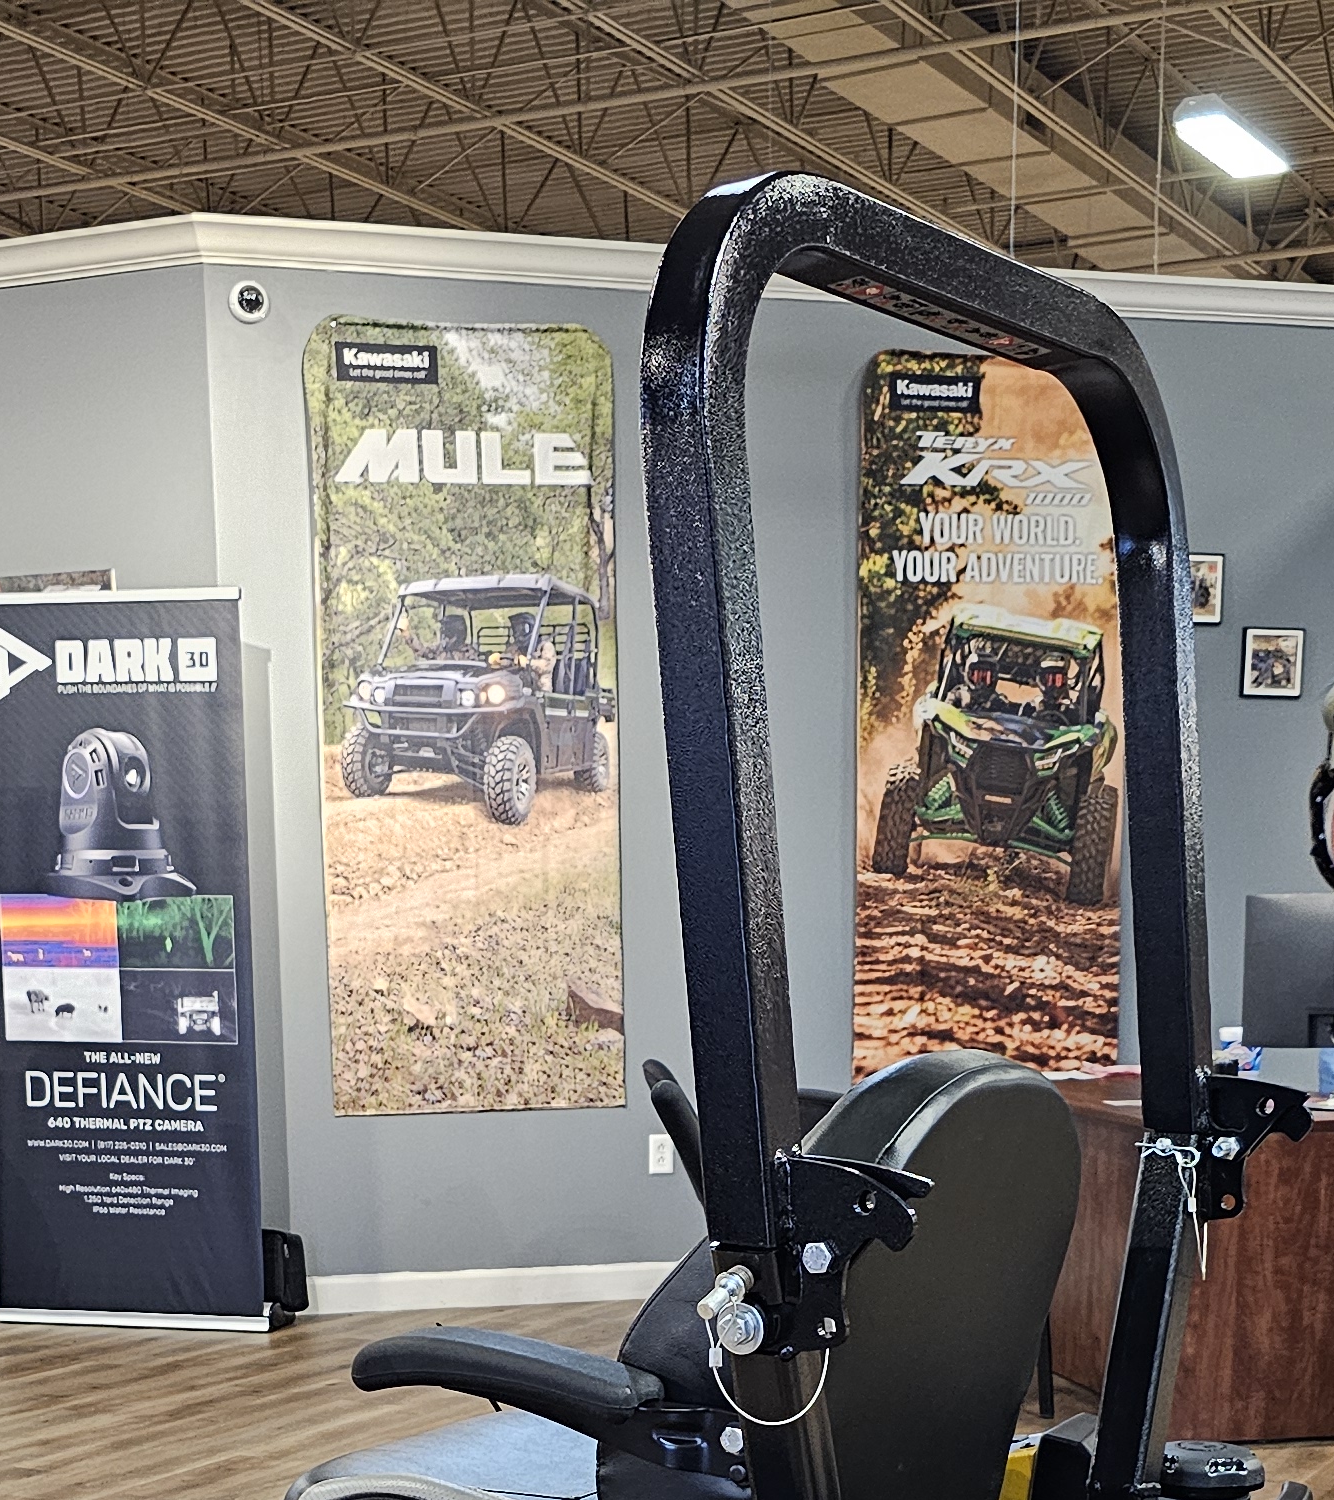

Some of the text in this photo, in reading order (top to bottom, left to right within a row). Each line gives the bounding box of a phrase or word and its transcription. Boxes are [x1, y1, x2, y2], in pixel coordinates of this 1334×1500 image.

[342, 347, 430, 369] Kawasaki
[896, 379, 974, 398] Kawasaki
[334, 428, 593, 486] MULE
[900, 451, 1095, 489] KRX
[1025, 492, 1093, 507] 1000
[918, 512, 1082, 546] YOUR WORLD.
[892, 549, 1103, 585] YOUR ADVENTURE.
[55, 638, 174, 683] DARK
[84, 1051, 161, 1065] THE ALL-NEW
[47, 1116, 205, 1132] 640 THERMAL PTZ CAMERA
[59, 1153, 76, 1162] VISIT
[77, 1154, 96, 1163] YOUR
[98, 1155, 119, 1163] LOCAL
[121, 1155, 147, 1164] DEALER
[149, 1156, 163, 1165] FOR
[164, 1157, 183, 1165] DARK
